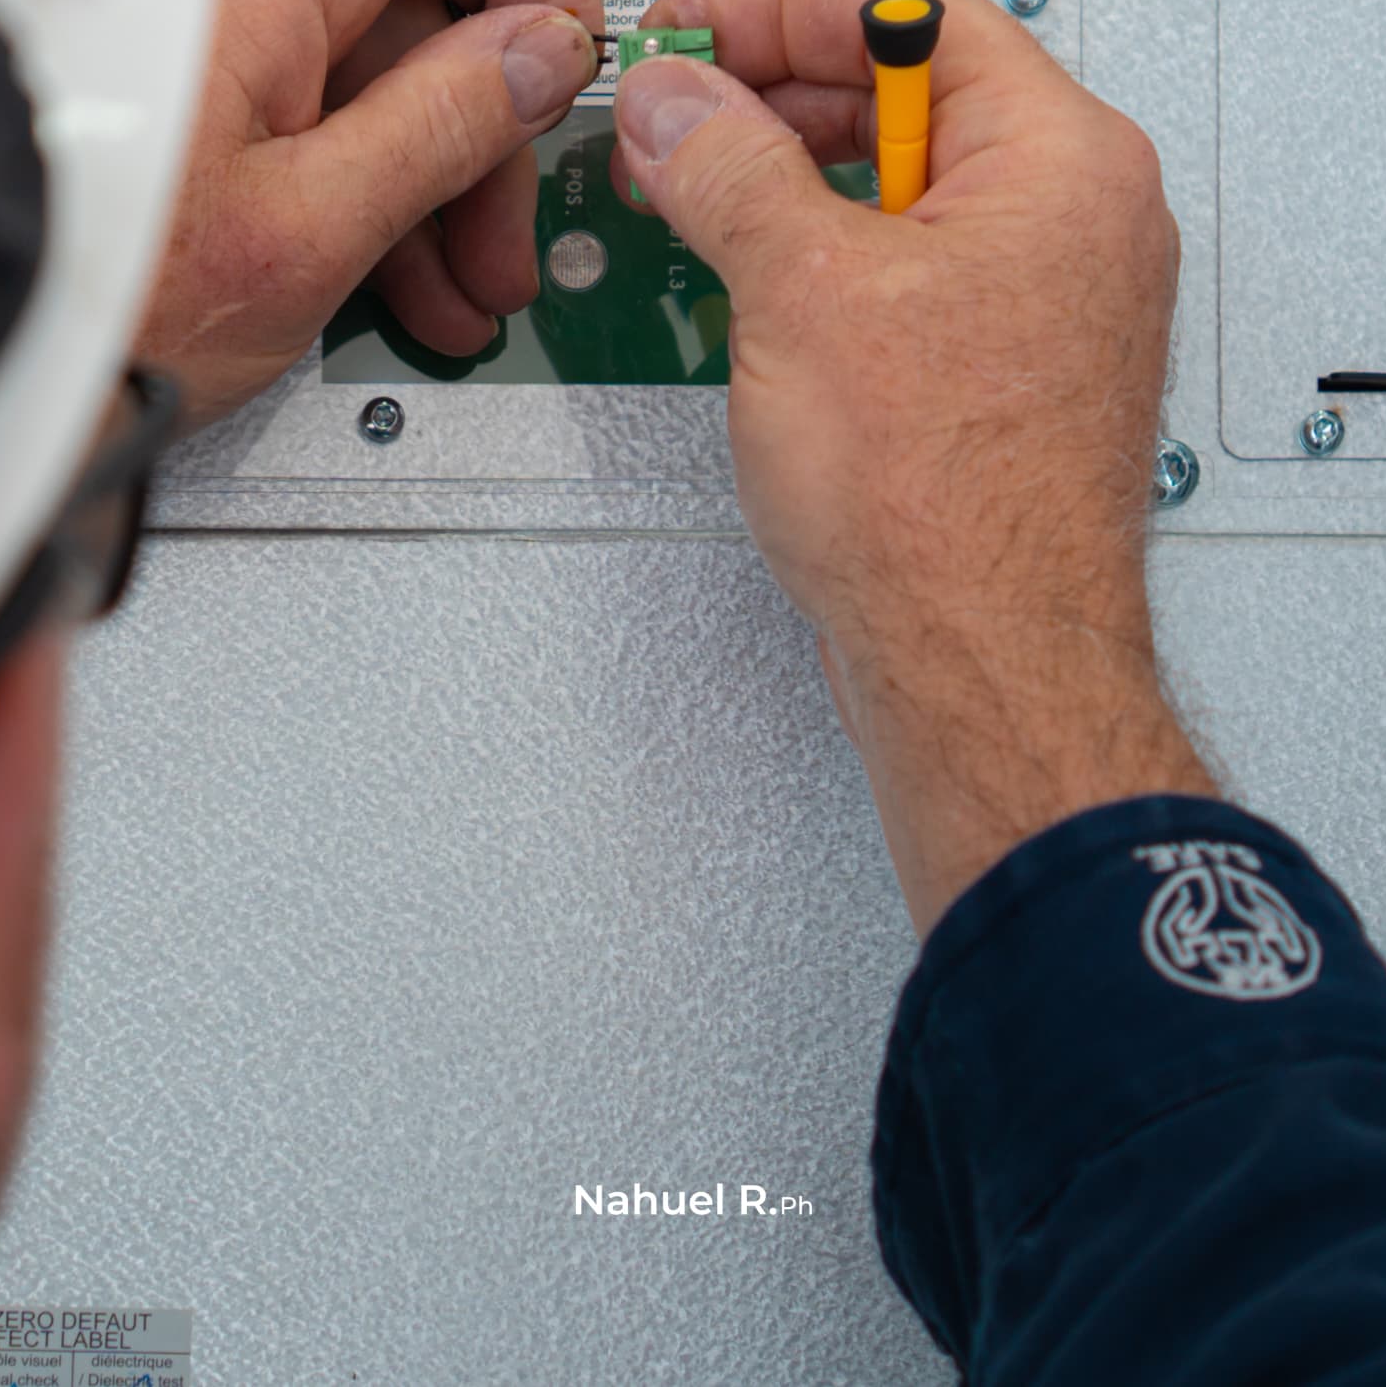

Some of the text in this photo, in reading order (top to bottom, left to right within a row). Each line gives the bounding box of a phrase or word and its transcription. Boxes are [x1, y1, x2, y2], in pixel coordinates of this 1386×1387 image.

[565, 168, 583, 215] POS.
[669, 265, 686, 290] L3
[63, 1312, 153, 1332] DEFAUT
[61, 1332, 131, 1350] LABEL
[21, 1354, 62, 1367] visuel
[91, 1355, 173, 1370] diélectrique
[17, 1373, 59, 1386] check
[157, 1374, 184, 1387] test
